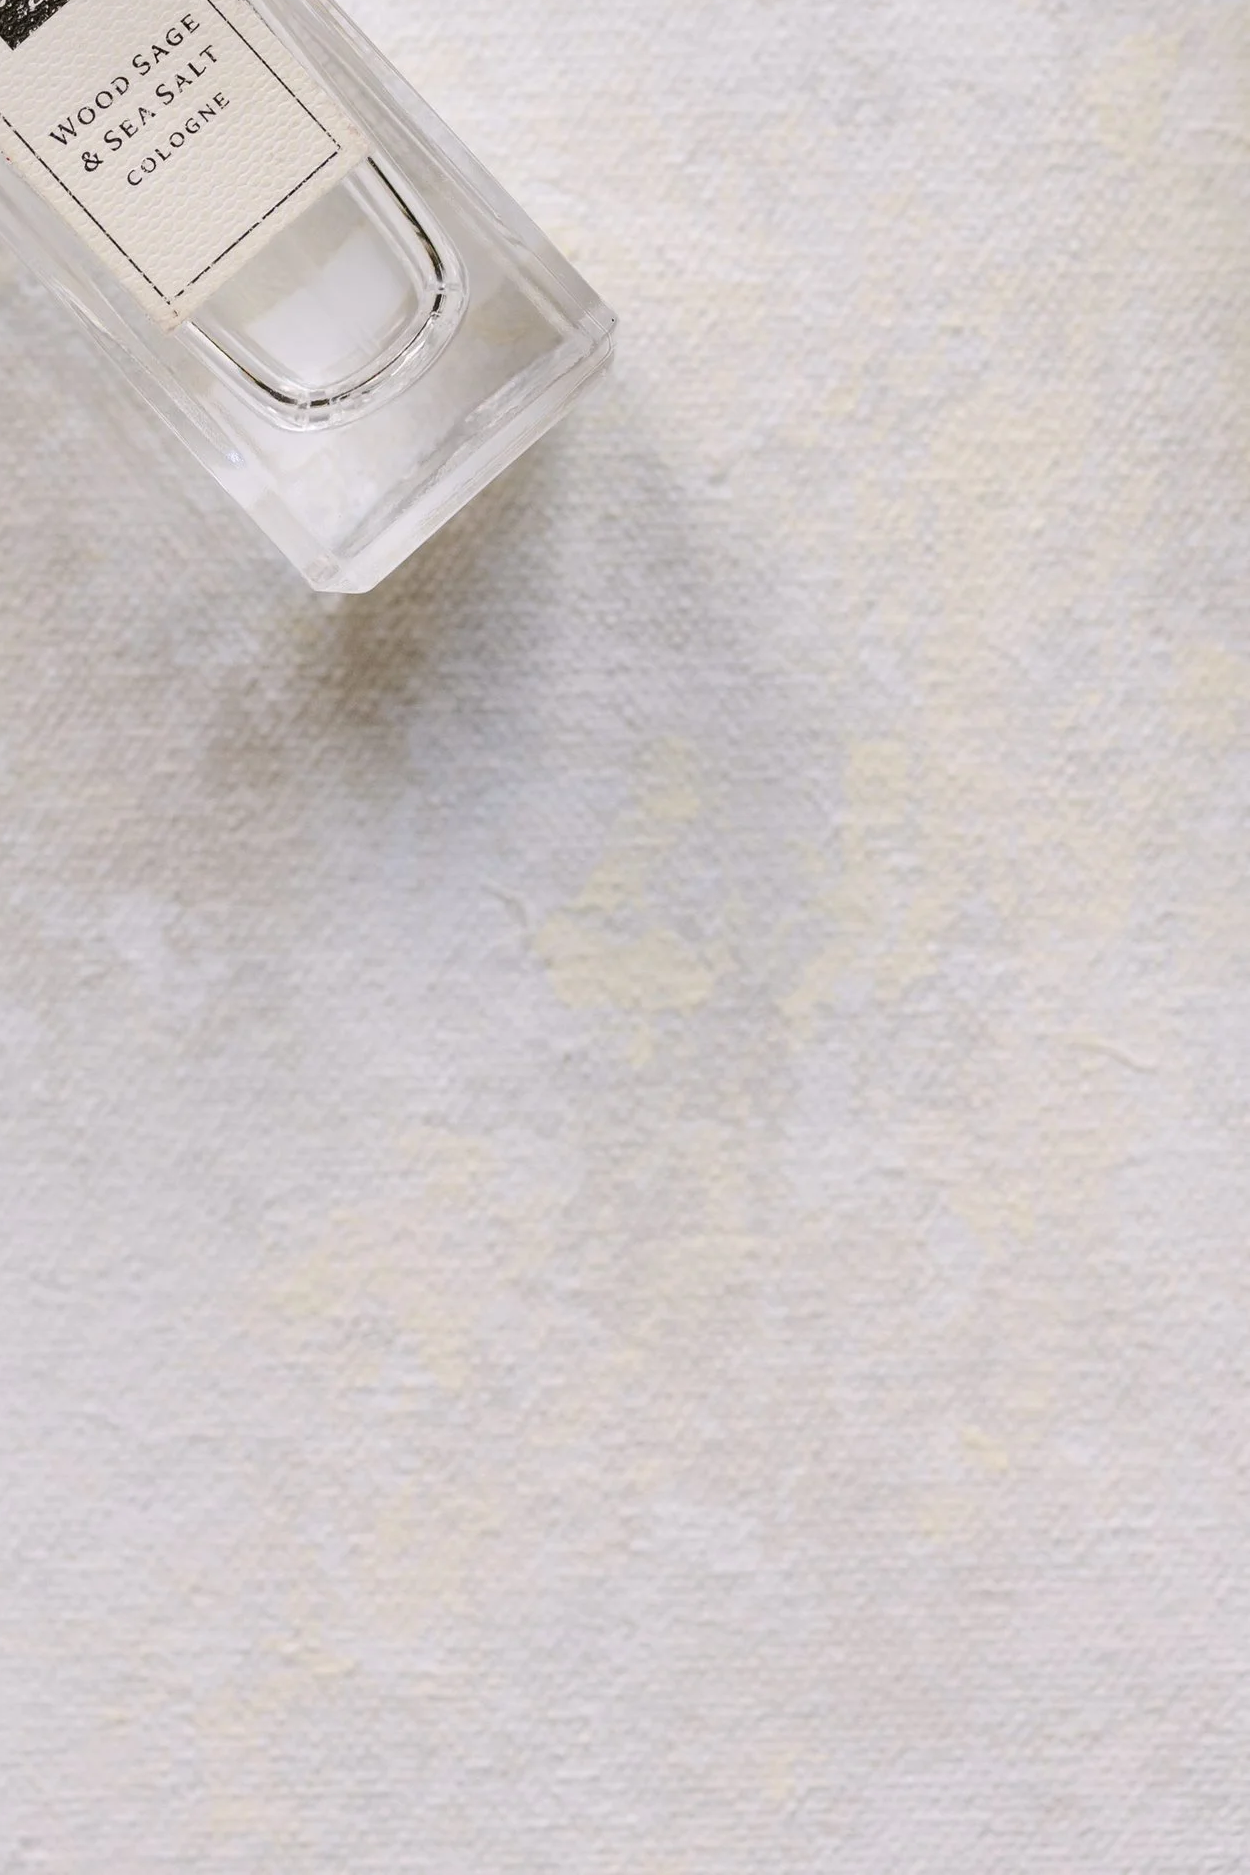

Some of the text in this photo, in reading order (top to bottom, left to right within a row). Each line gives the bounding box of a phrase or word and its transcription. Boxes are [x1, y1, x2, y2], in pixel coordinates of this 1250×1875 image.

[49, 13, 200, 146] WOOD SAGE
[81, 44, 217, 172] & SEA SALT
[127, 91, 230, 186] COLOGNE
